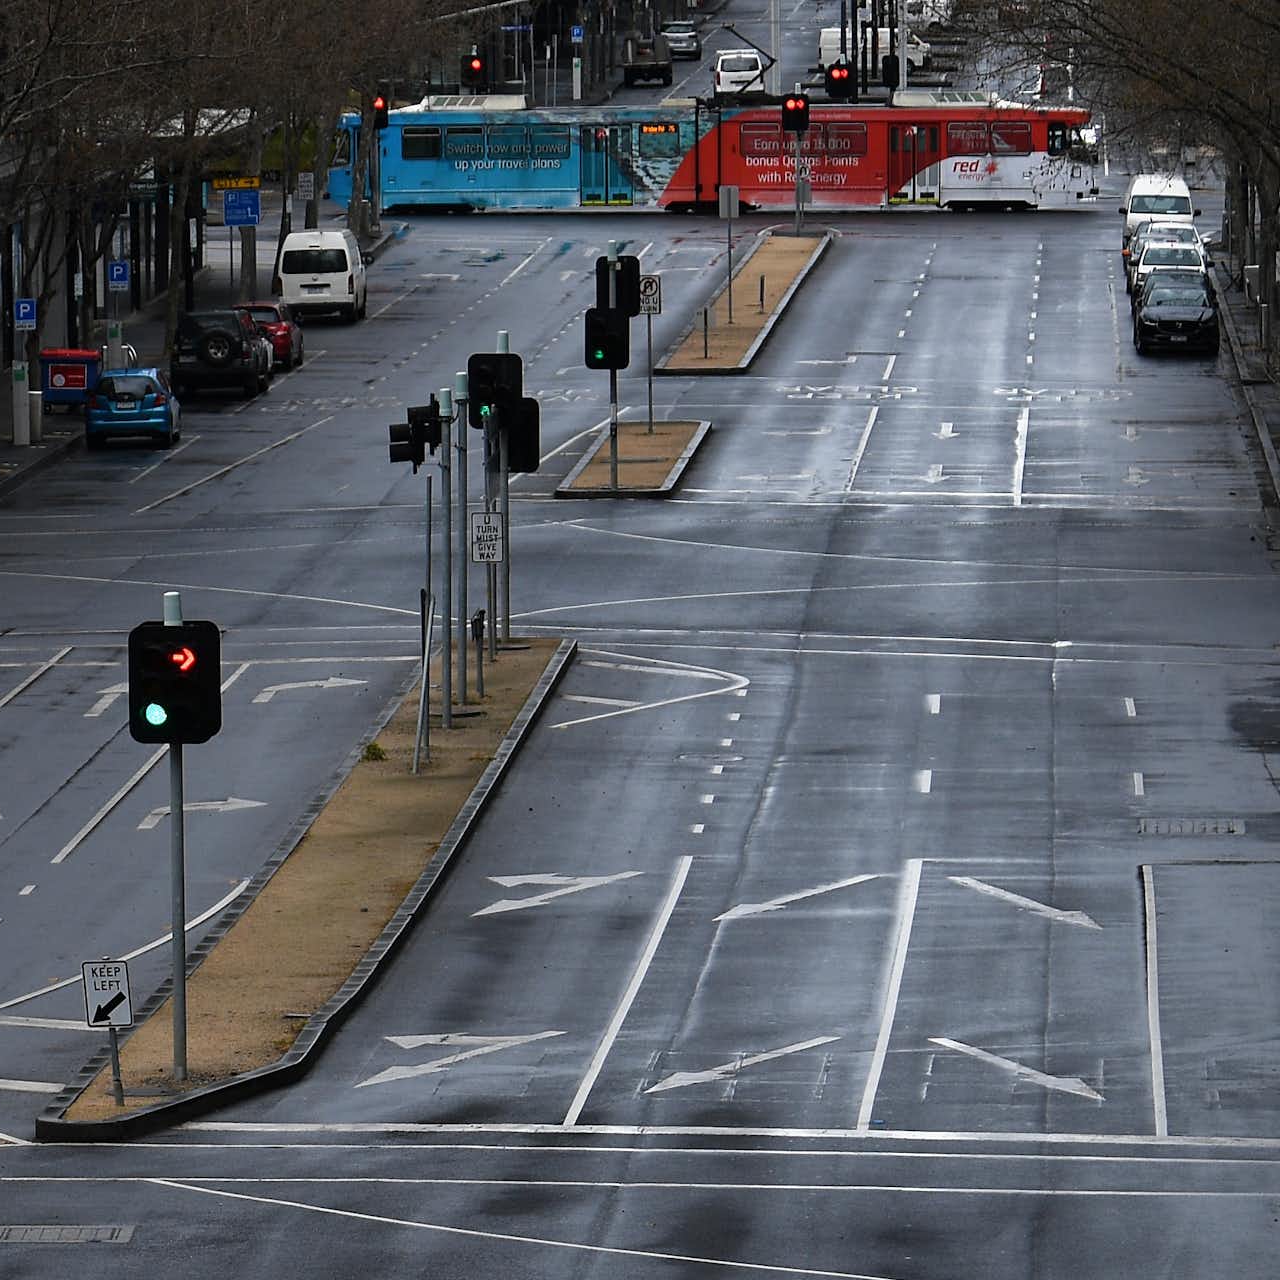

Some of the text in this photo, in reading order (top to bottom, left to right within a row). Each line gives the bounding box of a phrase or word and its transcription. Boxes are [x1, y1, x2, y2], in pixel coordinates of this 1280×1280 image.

[447, 143, 484, 153] Switch
[535, 143, 568, 155] power
[754, 138, 780, 150] Earn
[454, 160, 468, 172] up
[470, 159, 495, 172] your
[531, 158, 560, 171] plans
[745, 155, 780, 167] bonus
[953, 160, 980, 173] red
[757, 170, 781, 182] with
[809, 171, 847, 185] Energy
[958, 173, 985, 182] energy
[113, 266, 123, 279] P
[652, 296, 658, 305] U
[19, 303, 31, 318] P
[483, 515, 491, 524] U
[476, 525, 499, 533] TURN
[476, 534, 499, 542] MUST
[478, 543, 497, 551] GIVE
[479, 551, 496, 560] WAY
[91, 966, 121, 978] KEEP
[93, 980, 121, 991] LEFT
